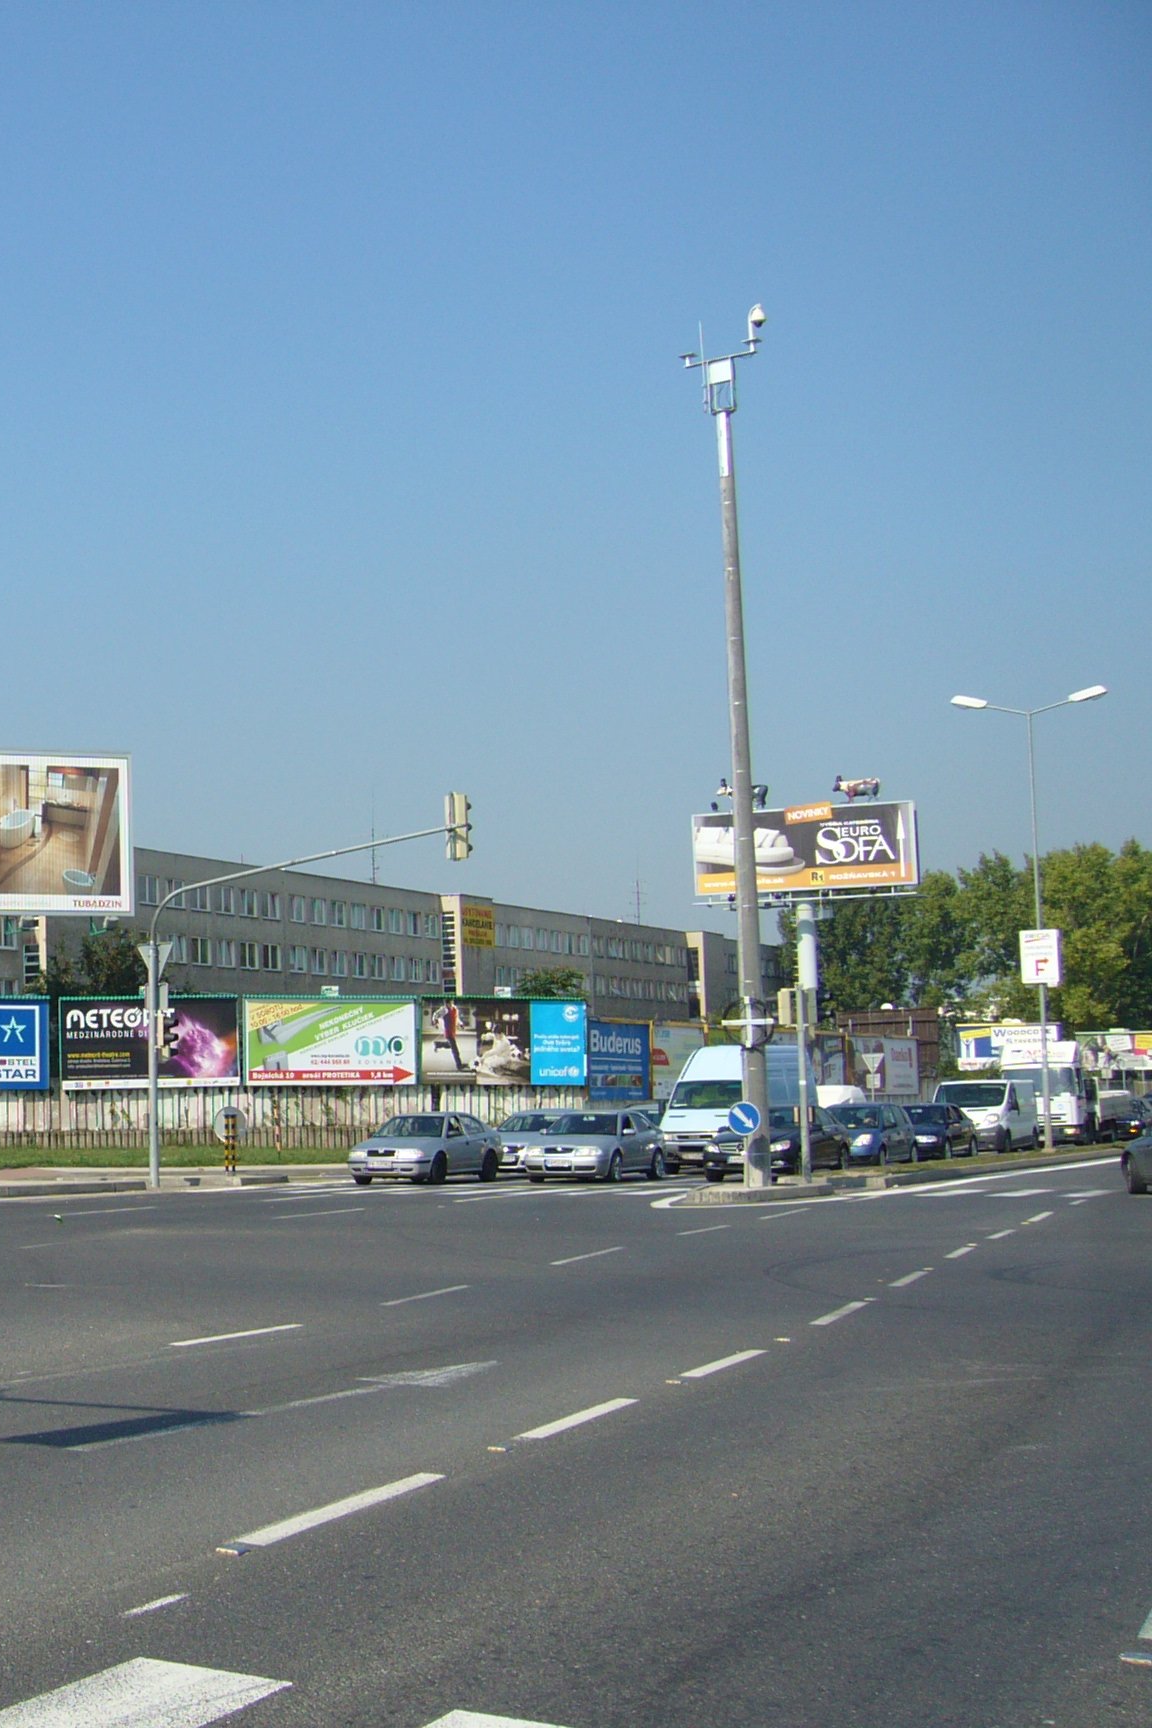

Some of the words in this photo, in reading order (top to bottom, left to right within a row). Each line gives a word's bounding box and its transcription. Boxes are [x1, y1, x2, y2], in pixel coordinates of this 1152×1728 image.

[786, 806, 830, 821] NOVINKY
[841, 825, 881, 837] EURO
[815, 827, 895, 865] SOFA
[72, 899, 122, 908] TUBADZIN
[66, 1030, 134, 1039] MEDZINÁRODNÉ
[590, 1030, 641, 1055] Buderus
[253, 1072, 283, 1080] Bojnická
[539, 1066, 567, 1077] unicef
